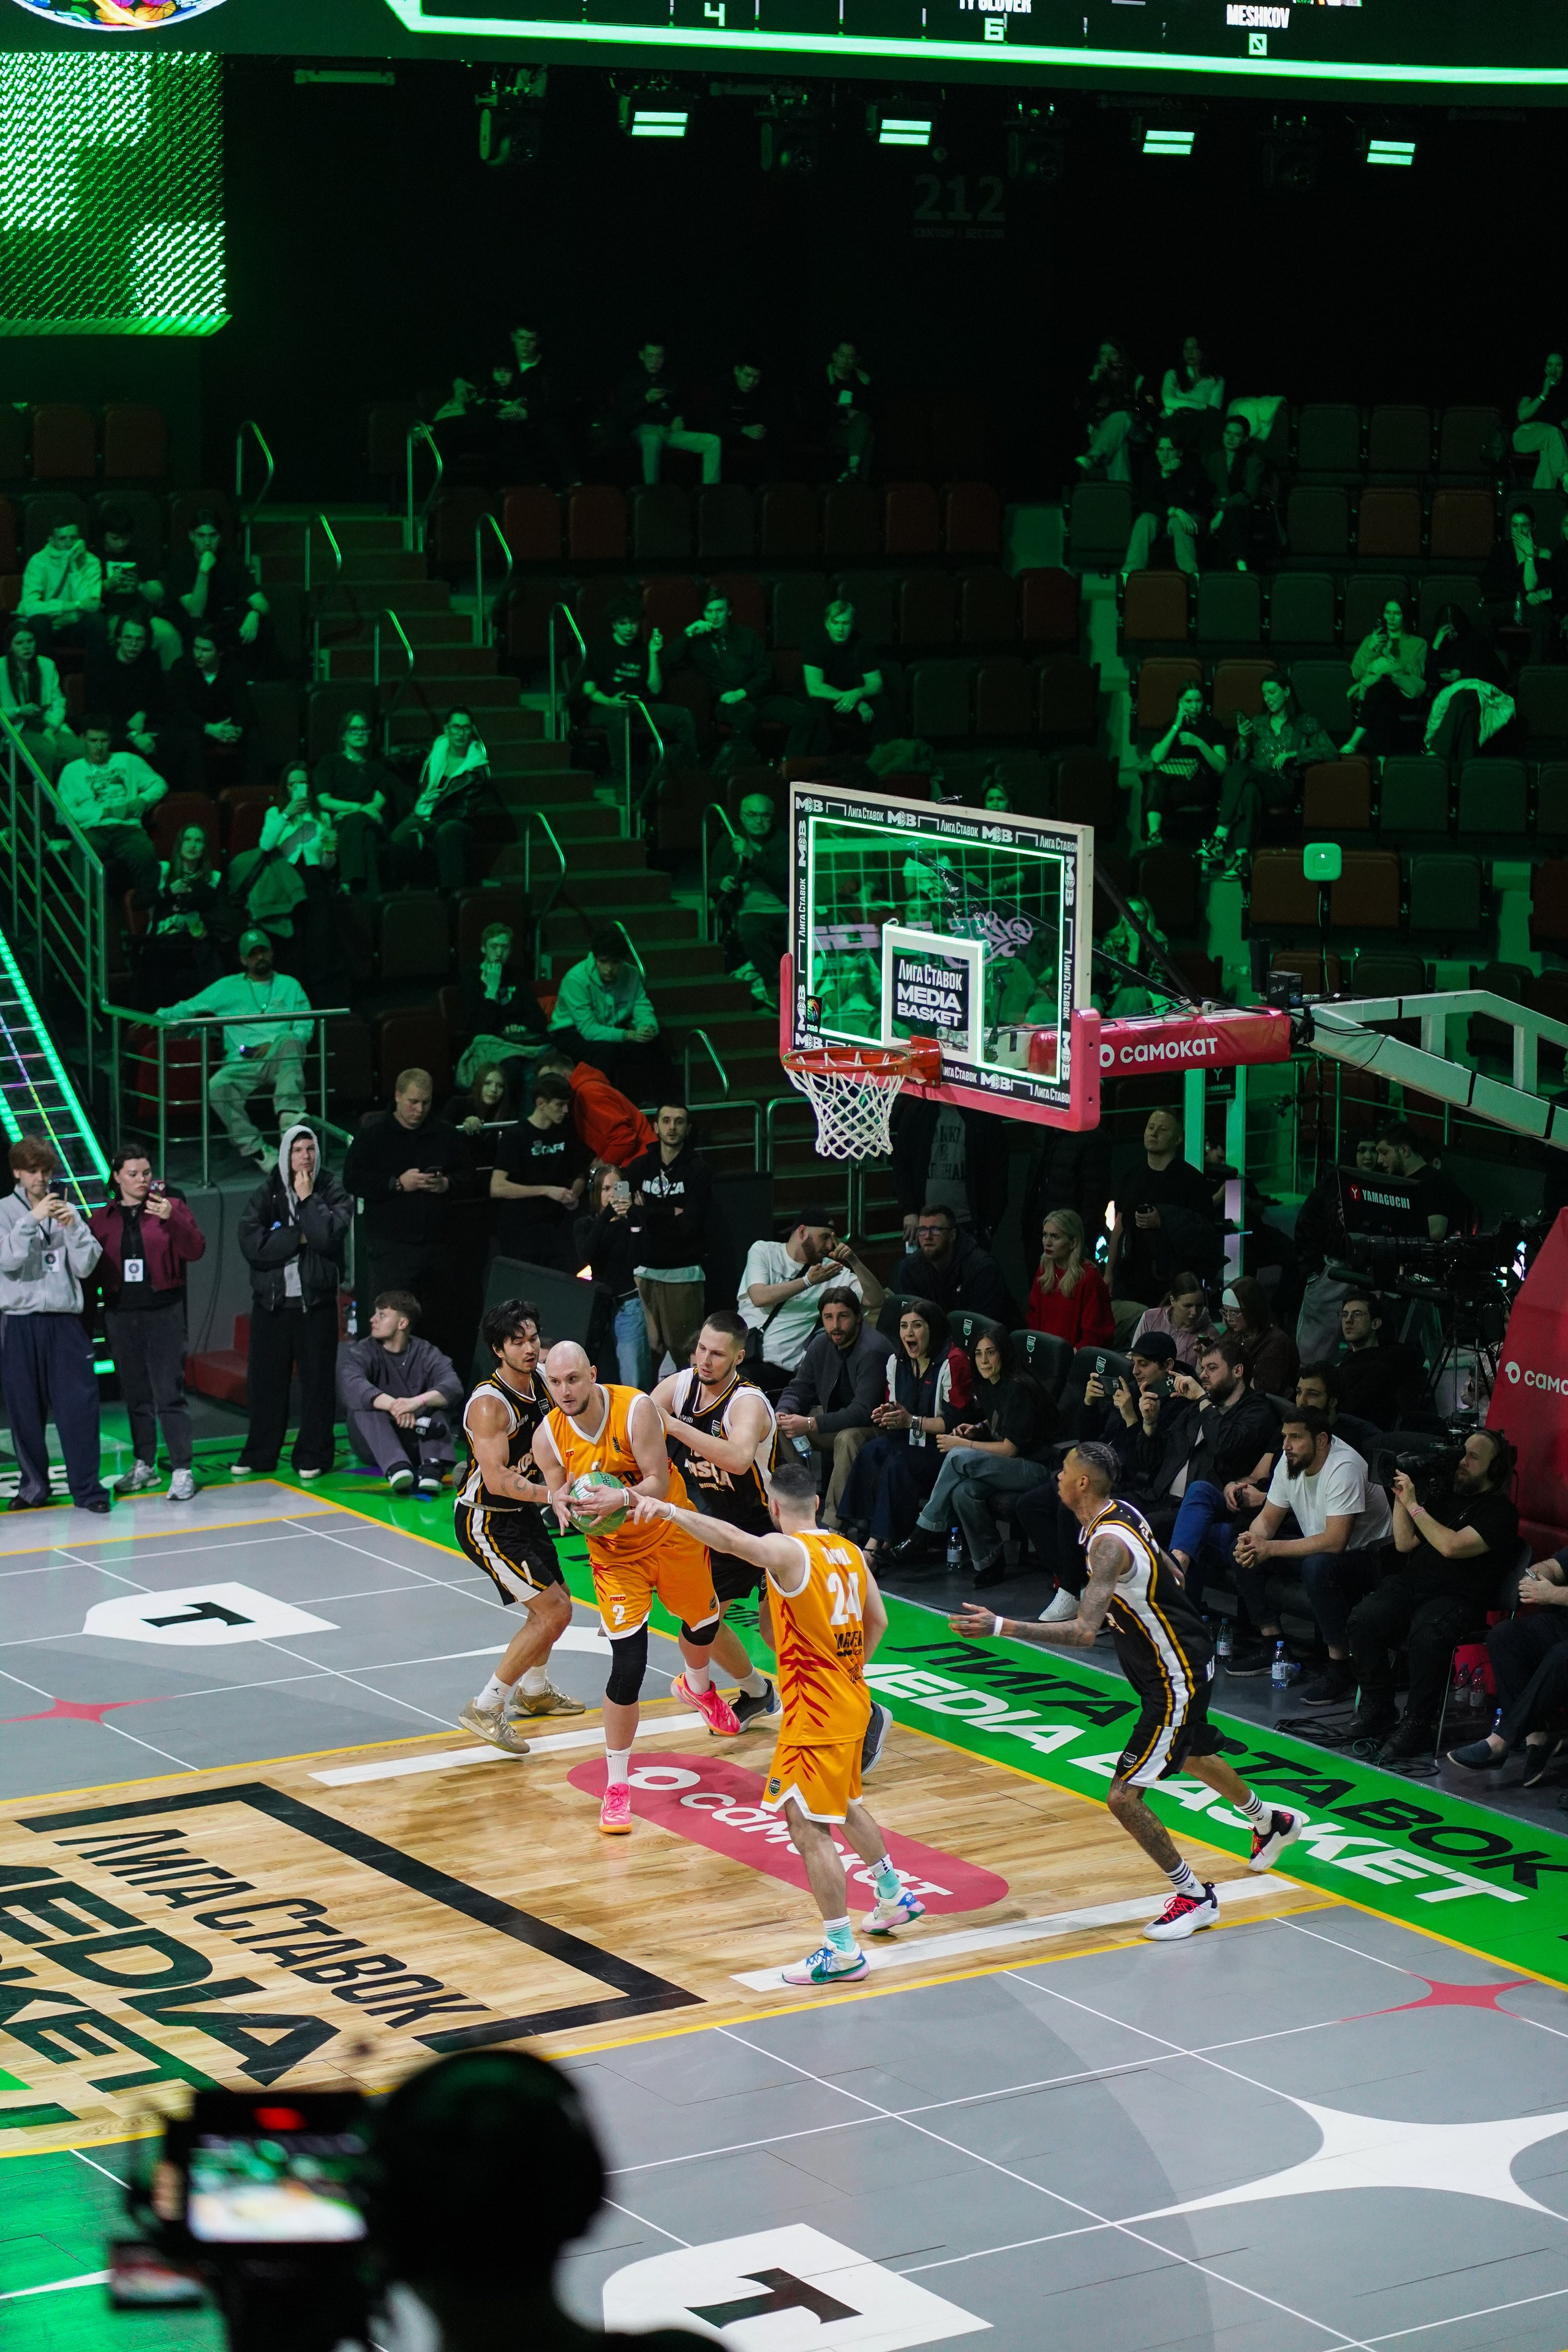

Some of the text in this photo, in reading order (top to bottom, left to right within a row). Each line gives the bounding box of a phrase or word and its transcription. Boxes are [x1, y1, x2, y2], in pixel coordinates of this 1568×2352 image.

[704, 2, 725, 26] 4
[1226, 4, 1291, 29] MESHKOV
[984, 17, 1005, 41] 6
[914, 173, 1006, 221] 212
[899, 959, 962, 992] ЛИГА СТАВОК
[897, 984, 962, 1012] MEDIA
[897, 1001, 962, 1027] BASKET
[1362, 1189, 1411, 1210] YAMAGUCHI
[827, 1572, 862, 1626] 24
[612, 1604, 627, 1626] 2
[885, 1641, 1568, 1890] ЛИГА ТАВОК
[55, 1829, 492, 2029] ЛИГА СТАВОК
